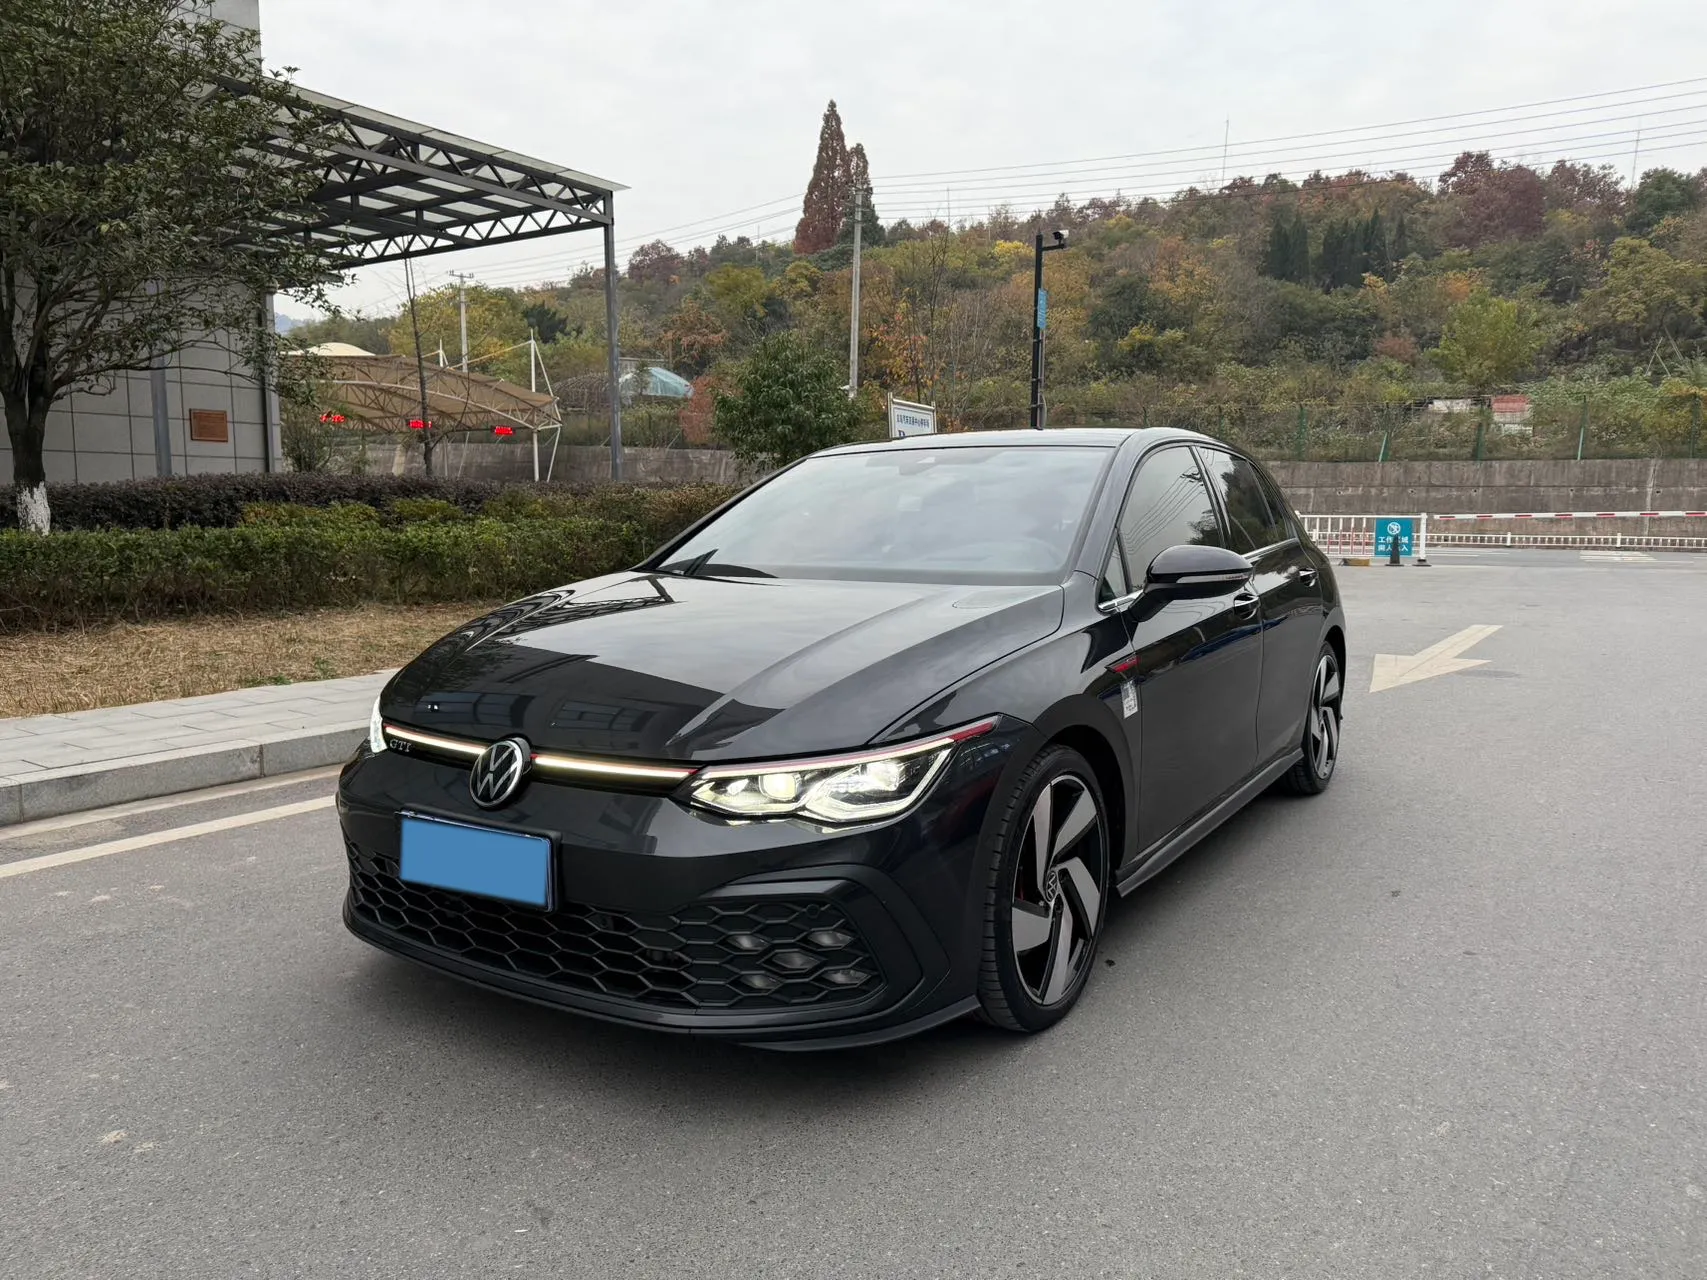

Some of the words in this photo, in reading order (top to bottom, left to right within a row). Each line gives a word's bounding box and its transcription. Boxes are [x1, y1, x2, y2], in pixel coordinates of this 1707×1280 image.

[1378, 536, 1409, 544] 工作域
[389, 738, 412, 753] GTI
